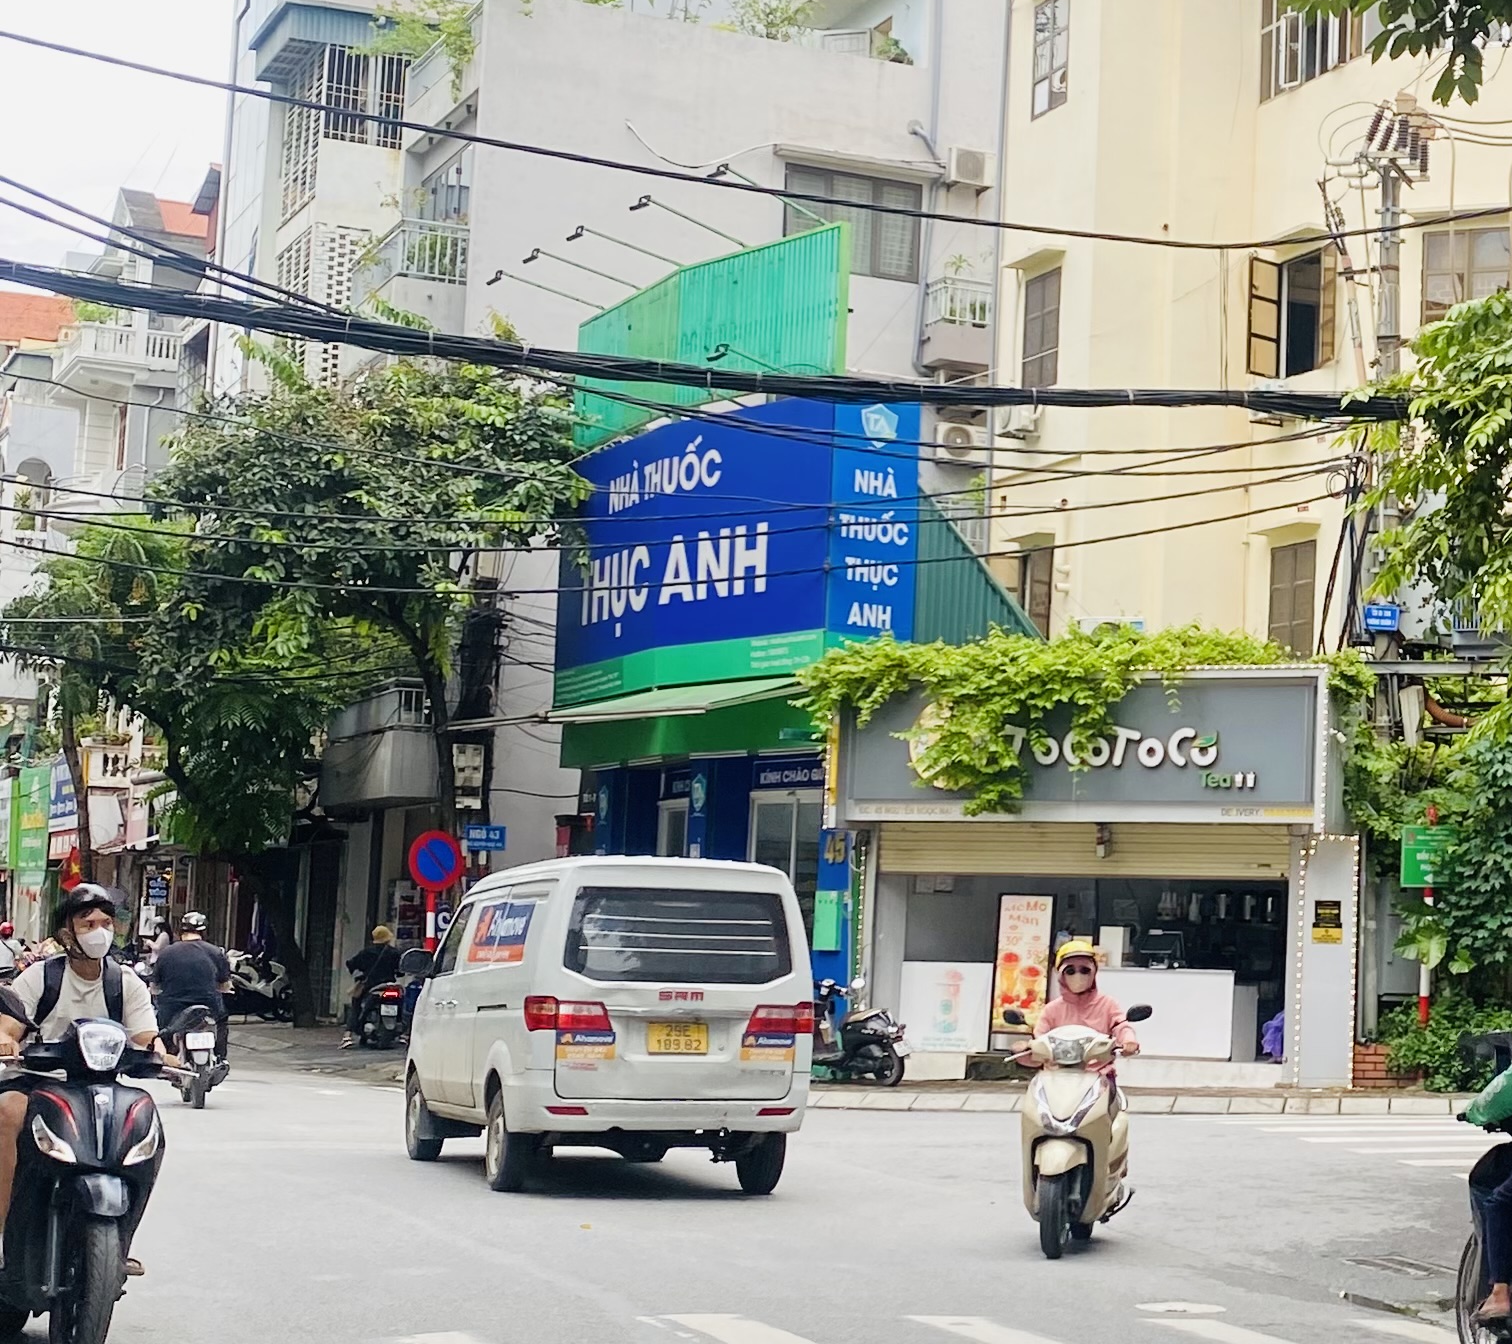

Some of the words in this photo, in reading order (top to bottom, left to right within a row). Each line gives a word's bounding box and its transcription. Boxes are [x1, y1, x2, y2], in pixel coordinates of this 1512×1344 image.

[609, 460, 641, 515] NHÀ
[643, 435, 723, 503] THUỐC
[854, 467, 897, 498] NHÀ
[839, 510, 908, 546] THUỐC
[580, 544, 651, 638] THỤC
[657, 522, 770, 606] ANH
[845, 556, 899, 591] THỤC
[847, 602, 892, 629] ANH
[1200, 771, 1232, 788] Tea
[825, 831, 846, 864] 45
